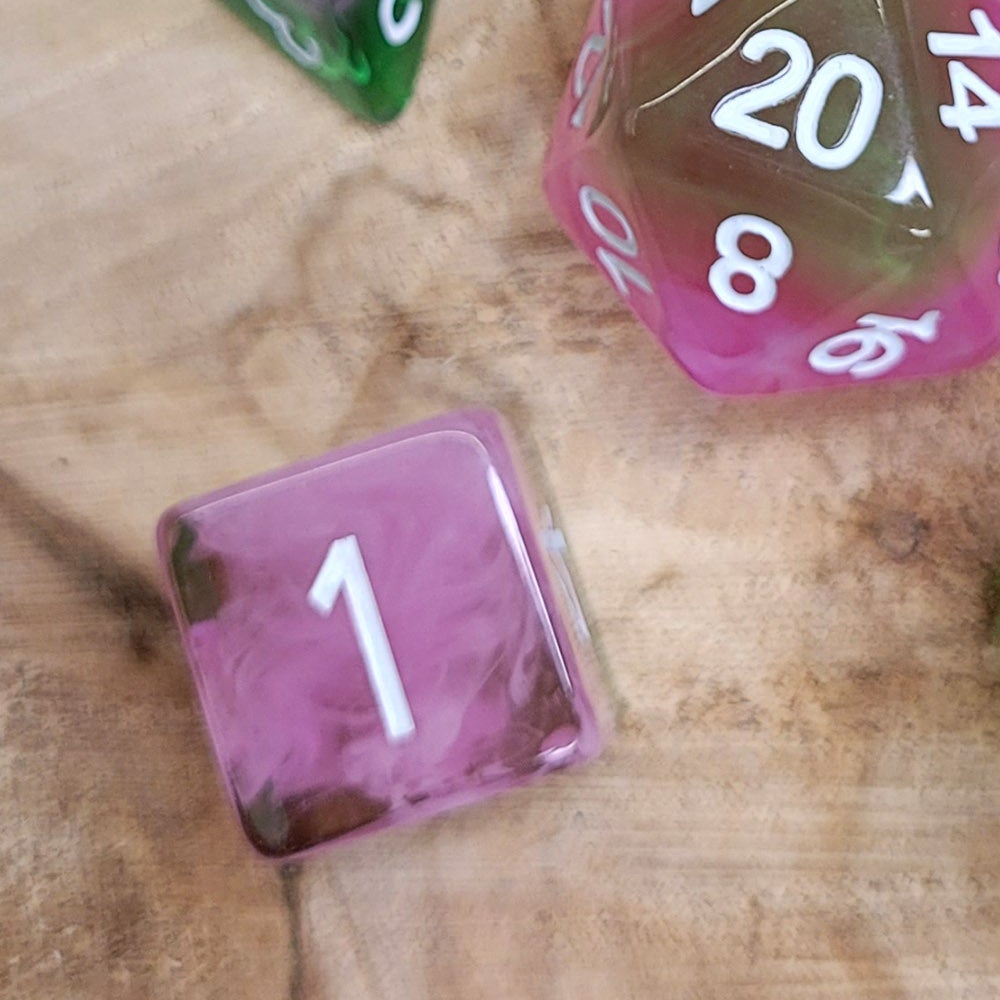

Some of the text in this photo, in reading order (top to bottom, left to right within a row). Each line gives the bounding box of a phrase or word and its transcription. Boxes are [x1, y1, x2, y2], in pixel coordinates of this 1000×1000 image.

[711, 28, 884, 170] 20
[578, 185, 655, 297] 10
[708, 213, 793, 314] 8
[808, 309, 942, 379] 16
[306, 534, 416, 745] 1
